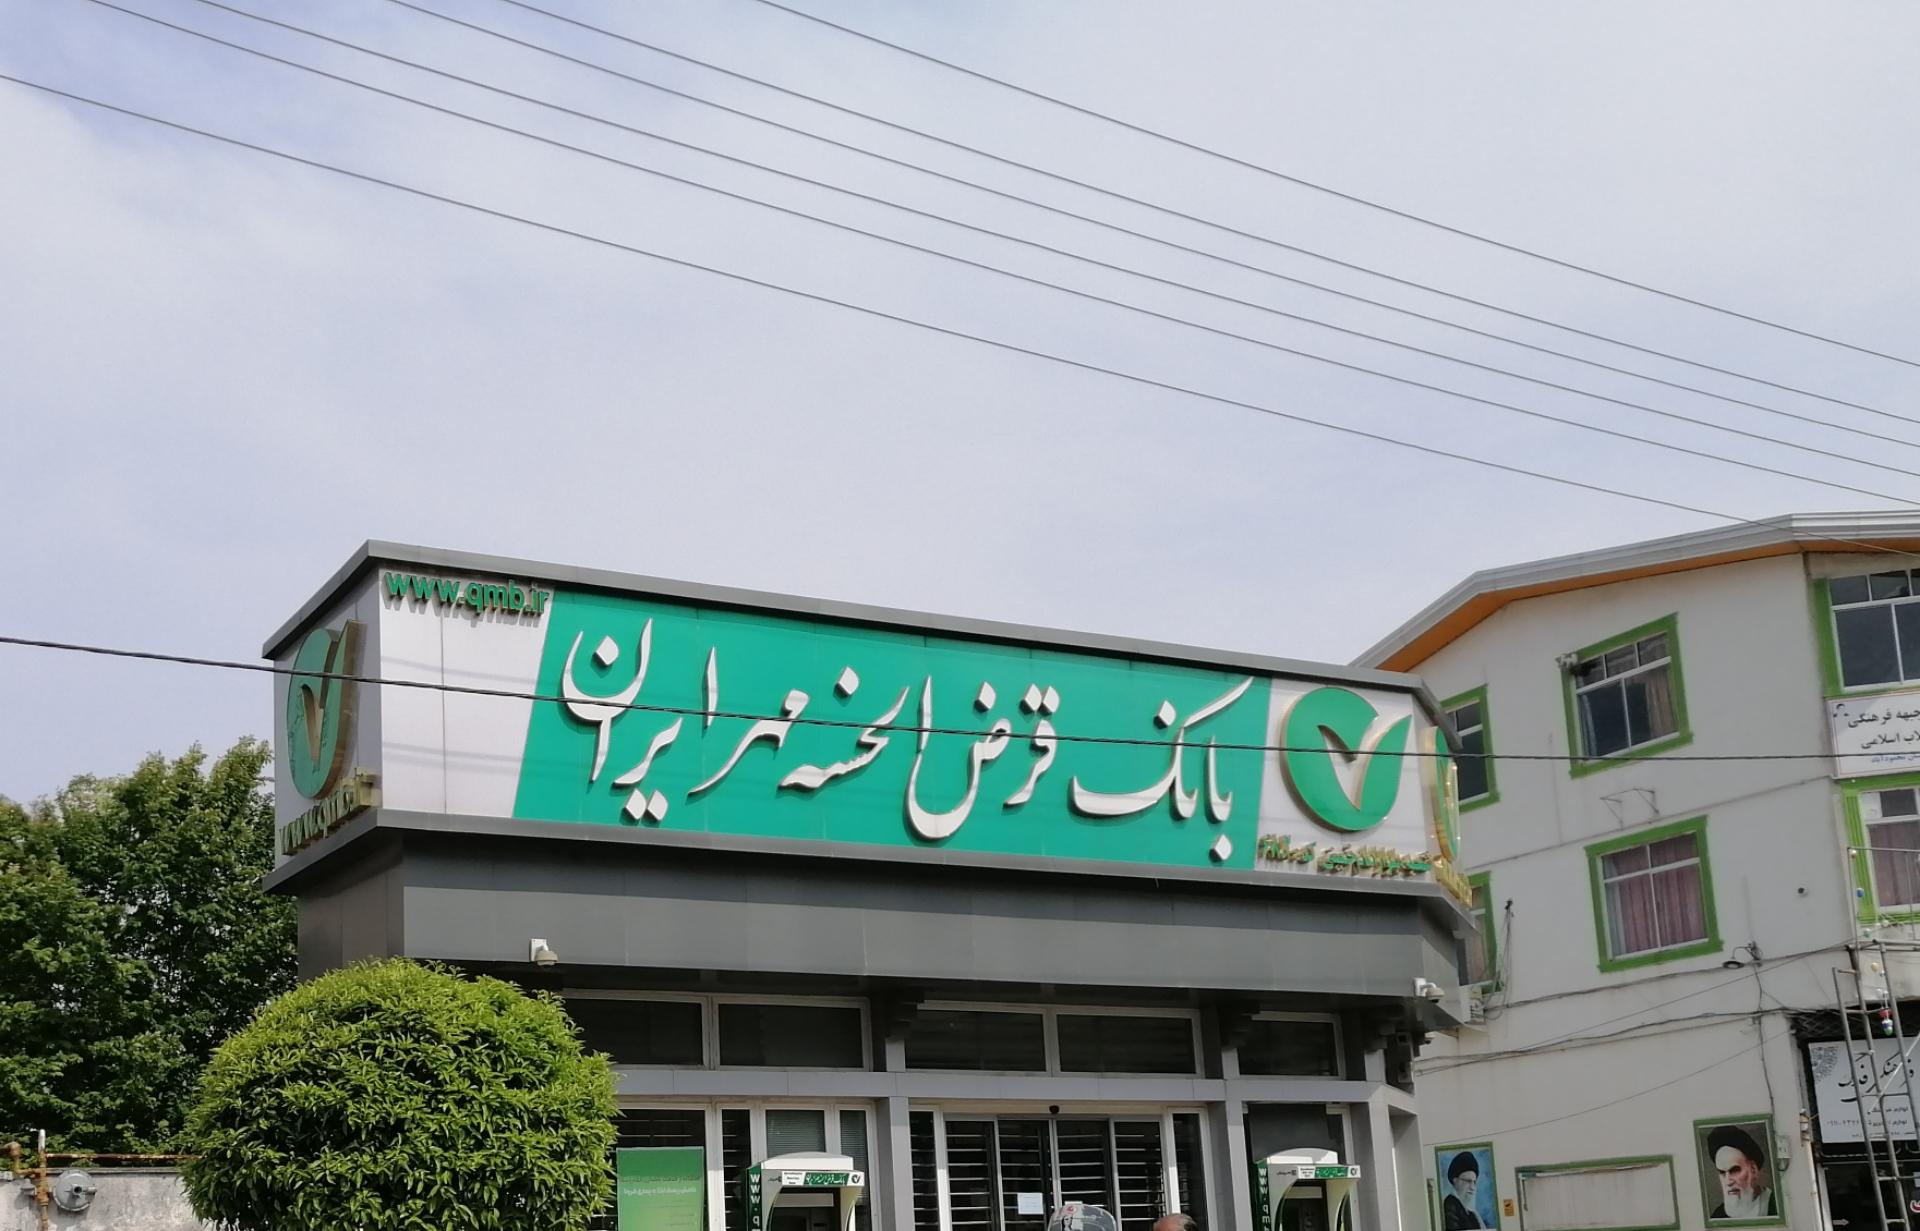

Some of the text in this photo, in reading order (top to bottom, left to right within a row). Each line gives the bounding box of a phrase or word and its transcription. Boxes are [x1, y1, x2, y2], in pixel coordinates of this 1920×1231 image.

[385, 571, 549, 614] www.qmb.ir
[560, 616, 719, 822] ایران
[687, 688, 811, 797] مهر
[907, 680, 1061, 839] قرض
[1072, 675, 1254, 861] بانک
[750, 1173, 761, 1231] www.q
